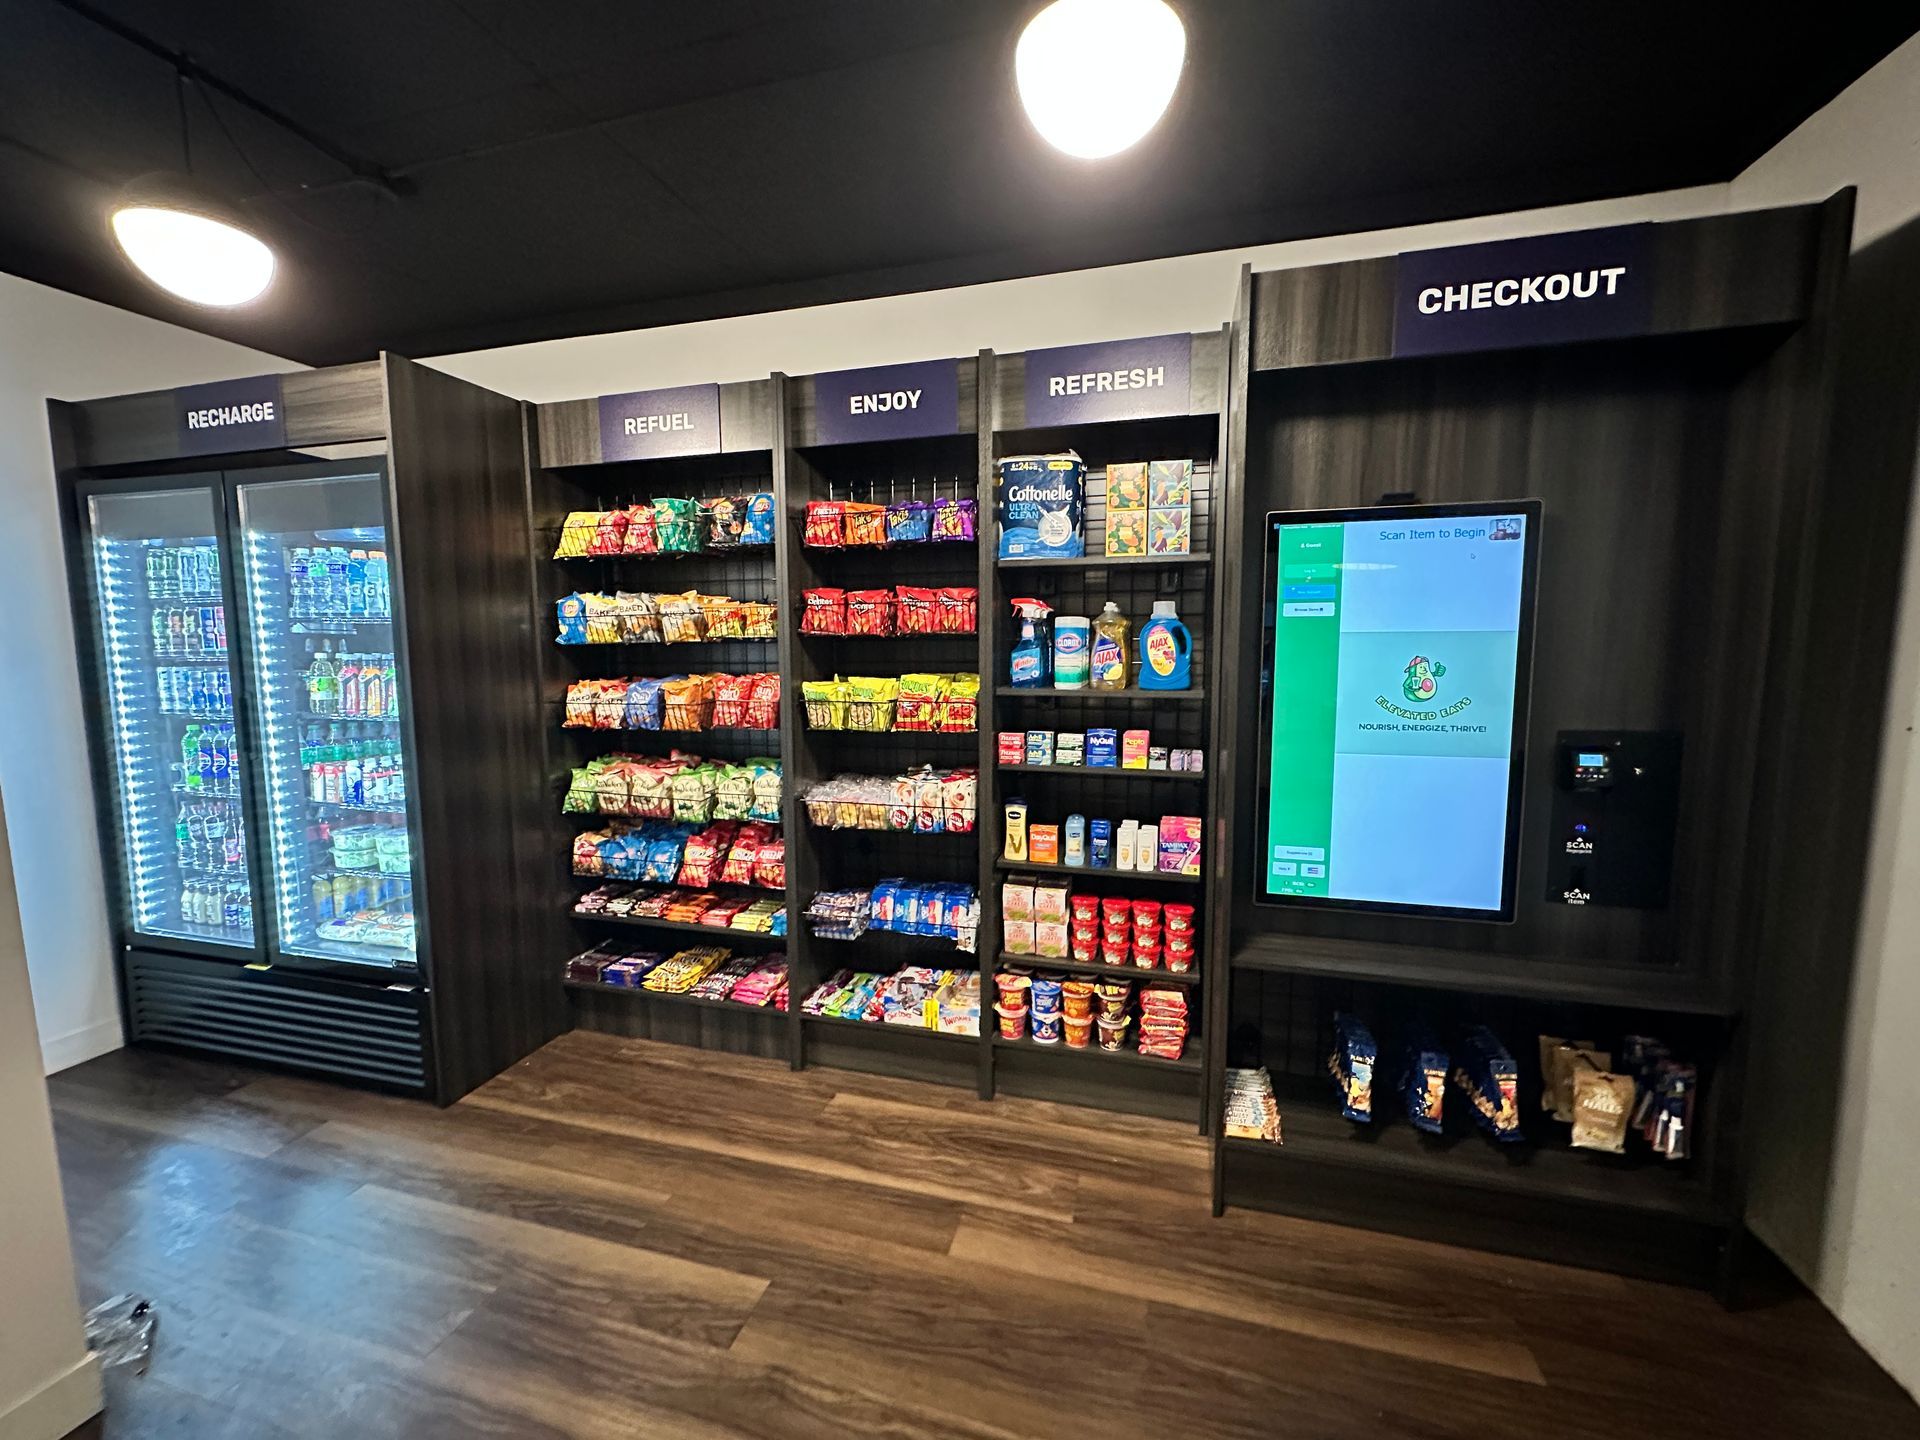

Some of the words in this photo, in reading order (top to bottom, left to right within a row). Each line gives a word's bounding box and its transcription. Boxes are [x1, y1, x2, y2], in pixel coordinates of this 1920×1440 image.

[1417, 266, 1626, 316] CHECKOUT
[1048, 366, 1165, 398] REFRESH
[849, 389, 922, 415] ENJOY
[187, 401, 275, 430] RECHARGE
[623, 412, 695, 436] REFUEL
[1008, 484, 1074, 503] Cottonelle
[1009, 502, 1038, 512] ULTRA
[1008, 510, 1040, 520] CLEAN
[1379, 530, 1406, 541] Scan
[1409, 529, 1436, 540] Item
[1439, 528, 1451, 539] to
[1453, 527, 1486, 540] Begin
[1150, 637, 1169, 650] AJAX
[1095, 649, 1118, 665] AJAX
[1375, 695, 1437, 721] ELEVATED
[1439, 696, 1472, 718] EATS
[1358, 723, 1401, 732] NOURISH,
[1401, 723, 1449, 733] ENERGIZE,
[1451, 724, 1487, 733] THRIVE!
[1089, 736, 1114, 746] NyQuil
[1125, 738, 1145, 746] Pepto
[1031, 833, 1056, 842] DayQuil
[1566, 841, 1593, 850] SCAN
[1563, 891, 1590, 900] SCAN
